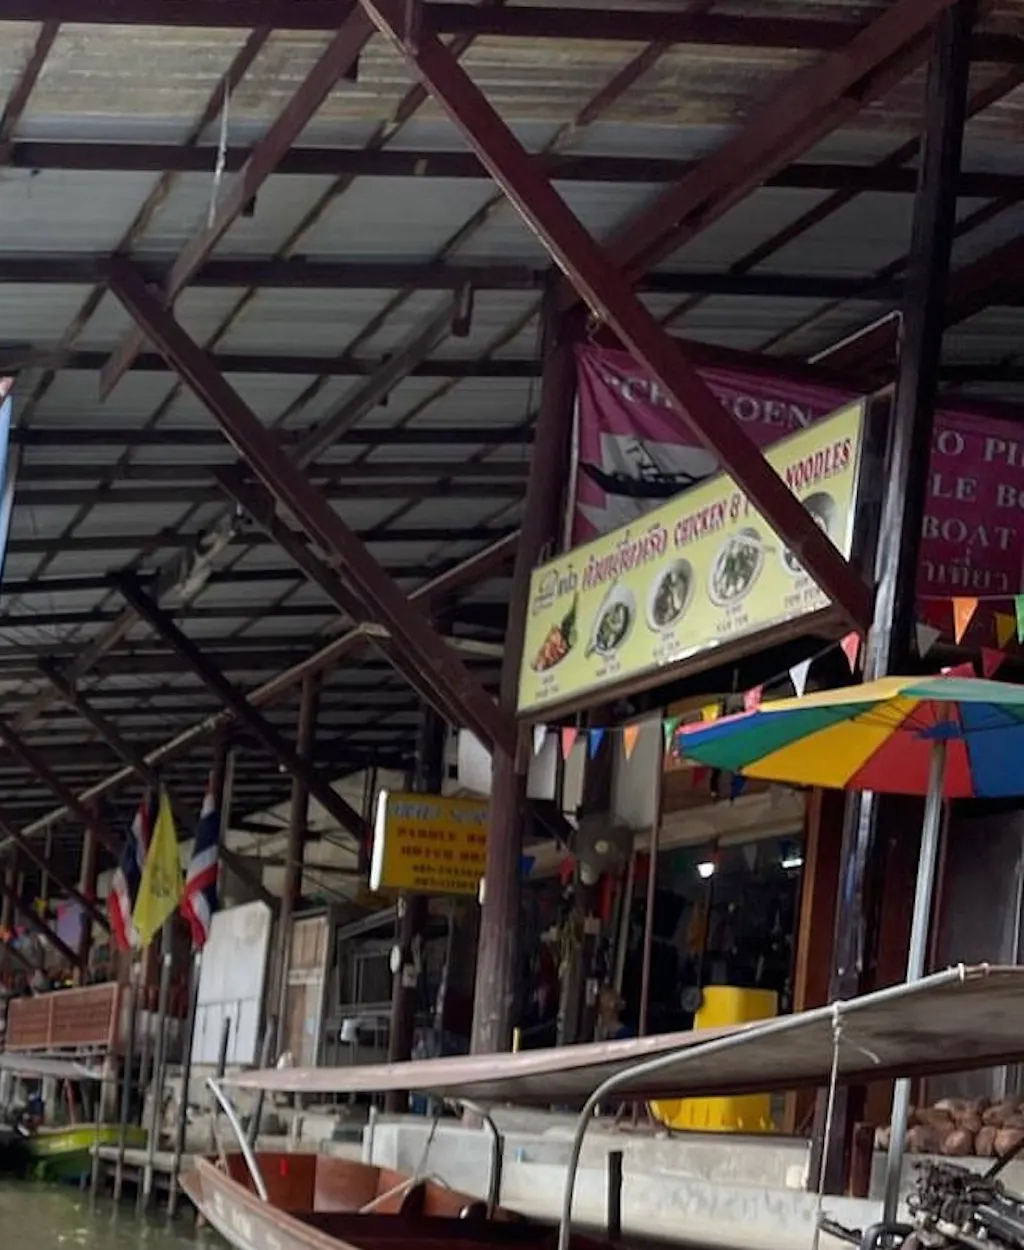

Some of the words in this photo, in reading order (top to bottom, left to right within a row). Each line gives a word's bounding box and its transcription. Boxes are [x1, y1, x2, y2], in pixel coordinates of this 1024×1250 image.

[983, 436, 1024, 468] PI
[673, 499, 728, 549] CHICKEN
[784, 438, 852, 489] NOODLES
[921, 514, 1017, 551] BOAT
